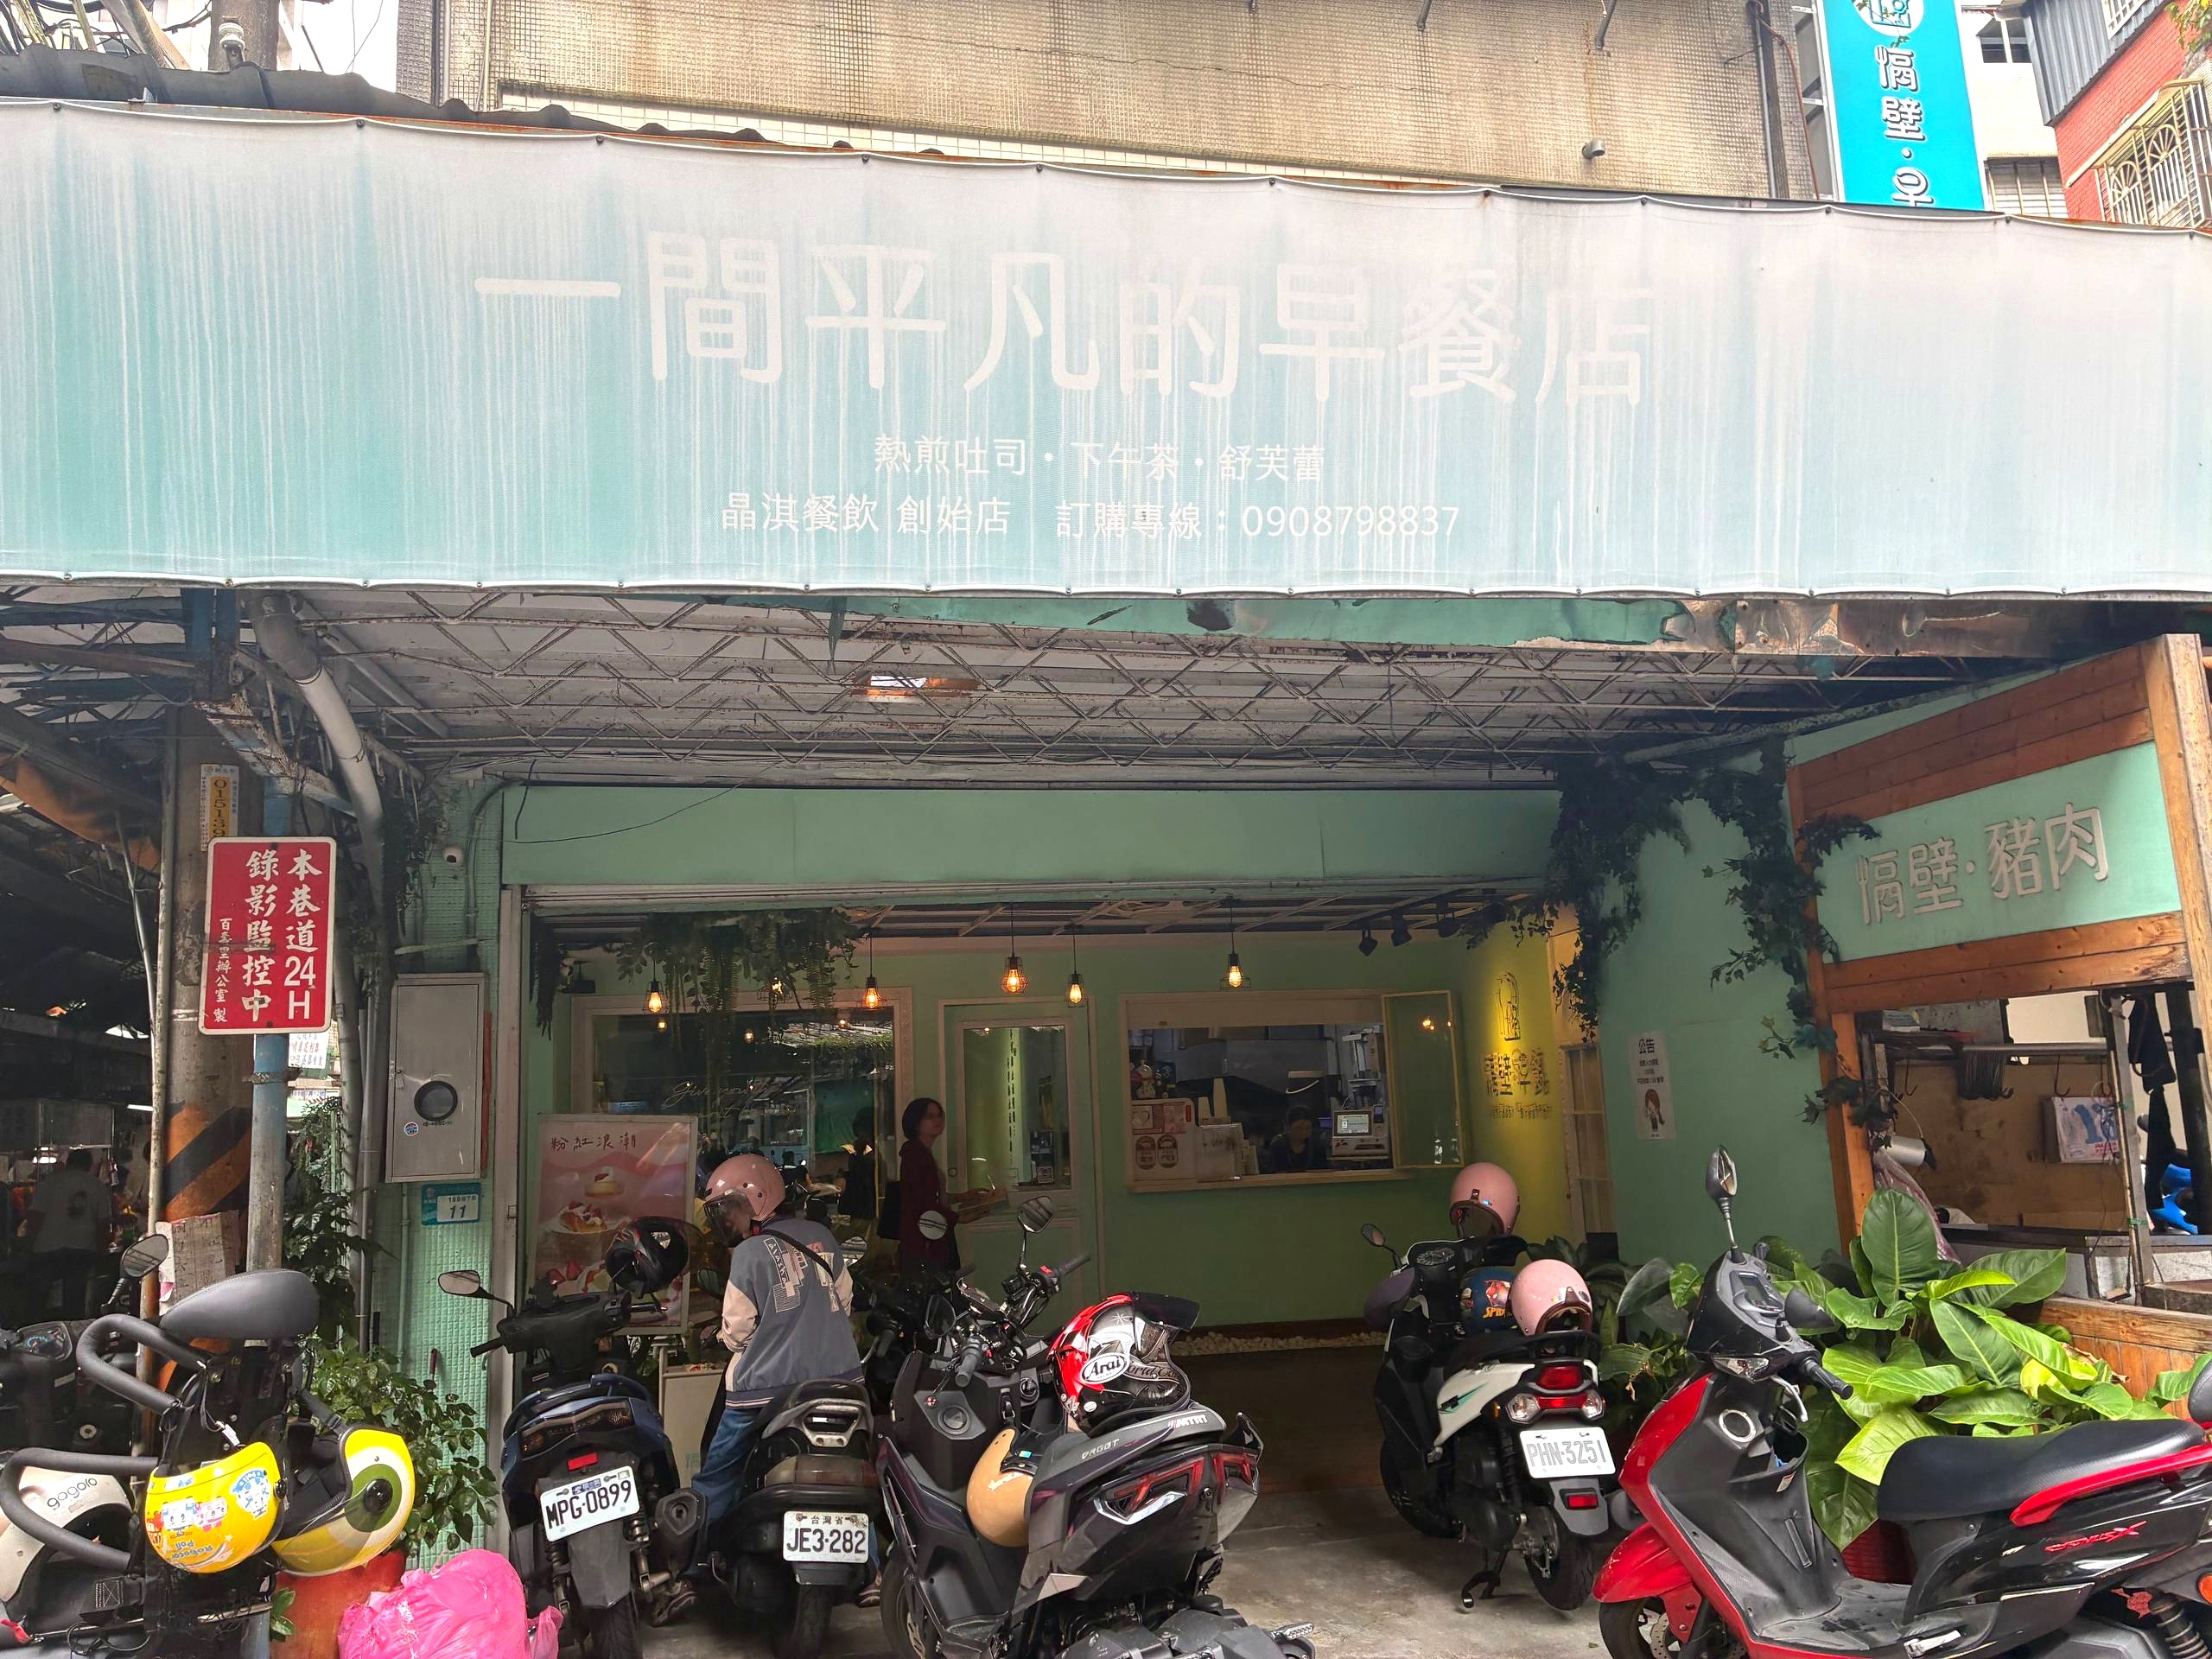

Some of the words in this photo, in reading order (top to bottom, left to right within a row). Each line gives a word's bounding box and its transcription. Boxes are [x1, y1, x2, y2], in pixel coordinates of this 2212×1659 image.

[474, 230, 1654, 406] 一間平凡的早餐店
[722, 492, 880, 533] 晶淇餐飲
[897, 495, 1011, 536] 創始店
[242, 849, 280, 1022] 錄影監控中
[1638, 1037, 1656, 1054] 公告
[551, 1132, 636, 1151] 粉紅浪潮
[450, 1205, 467, 1219] 11
[1087, 1356, 1122, 1380] Arai
[1526, 1440, 1606, 1467] PHN-3251
[47, 1478, 98, 1510] gogoro
[545, 1479, 632, 1529] MPG-0899
[786, 1528, 866, 1554] JE3-282
